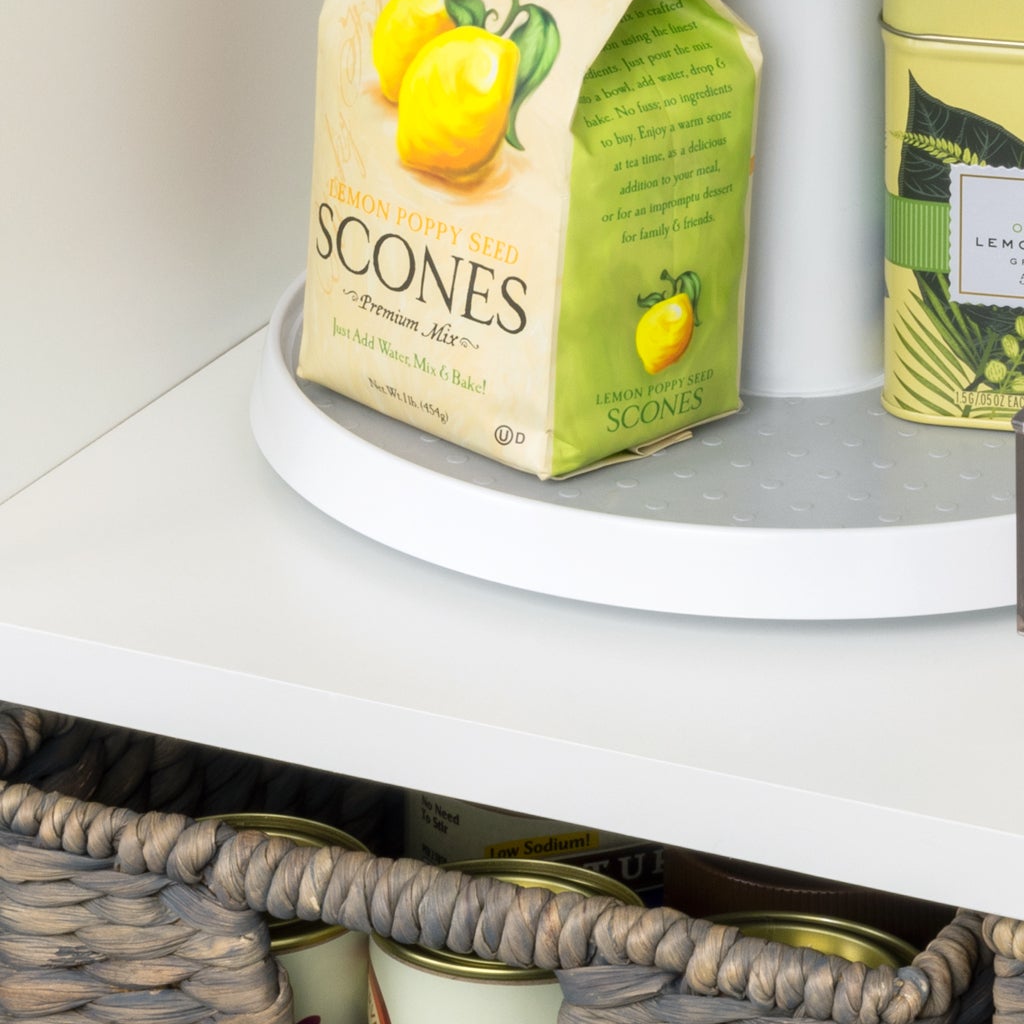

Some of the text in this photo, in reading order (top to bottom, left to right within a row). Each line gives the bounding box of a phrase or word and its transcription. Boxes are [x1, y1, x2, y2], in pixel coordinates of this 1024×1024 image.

[622, 33, 652, 49] using
[652, 26, 668, 38] the
[621, 58, 644, 72] Just
[648, 51, 671, 66] pour
[674, 44, 690, 56] the
[693, 42, 712, 52] mix
[595, 94, 602, 102] a
[637, 75, 655, 89] add
[657, 70, 689, 83] water,
[690, 64, 714, 76] drop
[715, 57, 726, 68] &
[584, 114, 614, 128] bake.
[614, 105, 636, 120] No
[664, 98, 677, 107] no
[680, 83, 733, 106] ingredients
[600, 139, 613, 148] to
[613, 132, 636, 147] buy.
[637, 124, 667, 140] Enjoy
[678, 117, 704, 130] warm
[706, 110, 732, 124] scone
[613, 162, 622, 172] at
[625, 159, 639, 169] tea
[668, 149, 677, 159] as
[680, 147, 686, 156] a
[688, 136, 727, 154] delicious
[619, 179, 658, 196] addition
[661, 176, 671, 186] to
[673, 169, 693, 186] your
[328, 177, 519, 265] LEMON POPPY SEED
[601, 183, 733, 223] or for an impromptu dessert
[621, 230, 637, 244] for
[639, 223, 670, 240] family
[672, 218, 681, 232] &
[316, 202, 527, 334] SCONES
[358, 294, 459, 347] Premium Mix
[332, 317, 487, 395] Just Add Water, Mix & Bake!
[596, 369, 714, 405] LEMON POPPY SEED
[606, 387, 704, 433] SCONES
[434, 802, 460, 826] Need
[523, 833, 590, 855] Sodium!
